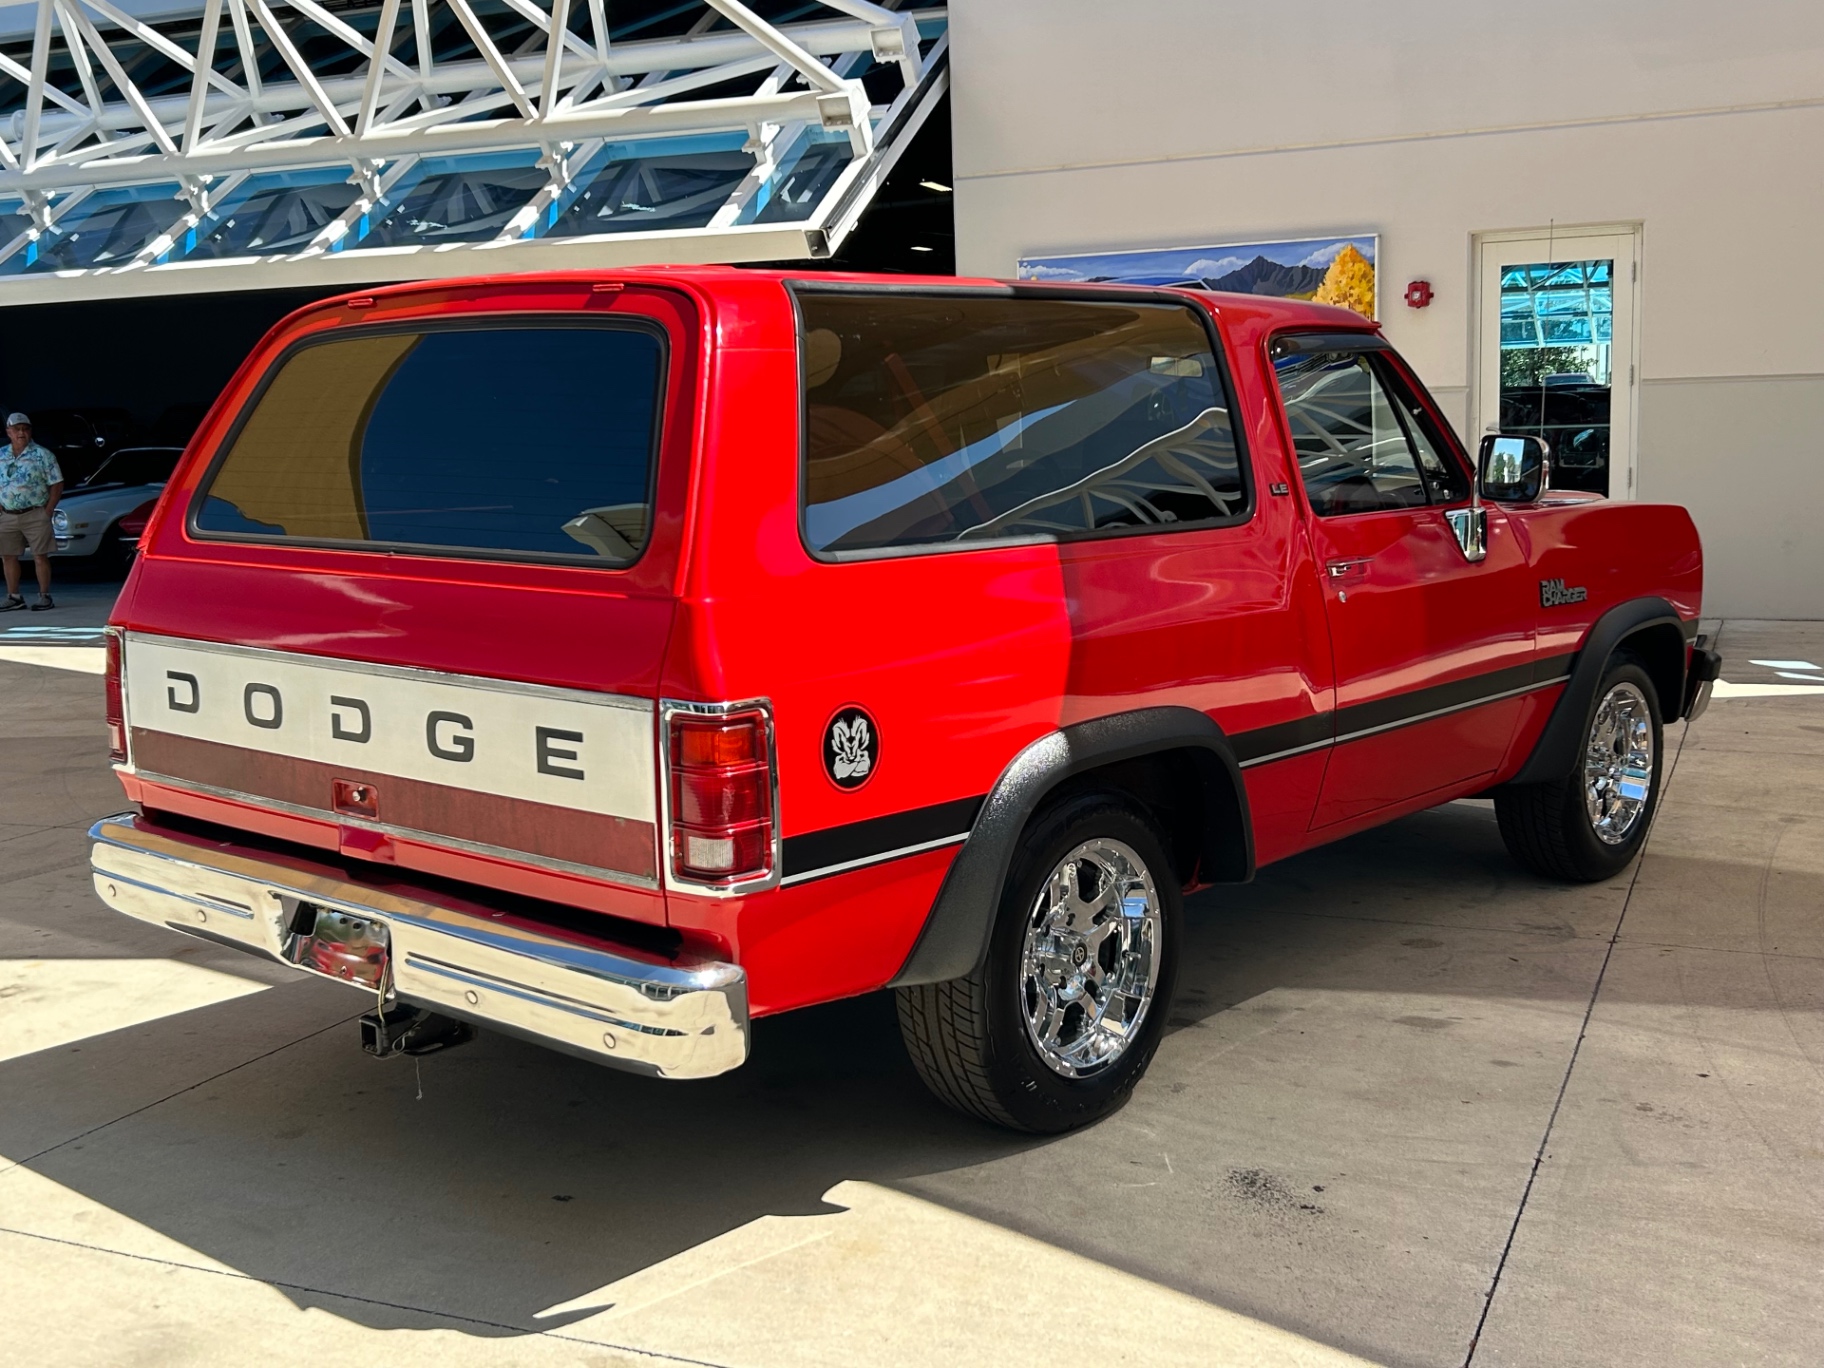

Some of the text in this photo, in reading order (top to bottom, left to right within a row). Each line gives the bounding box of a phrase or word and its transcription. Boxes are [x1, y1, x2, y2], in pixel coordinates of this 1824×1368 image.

[1271, 483, 1289, 494] LE
[1542, 586, 1588, 607] CHARGER
[166, 670, 585, 781] DODGE
